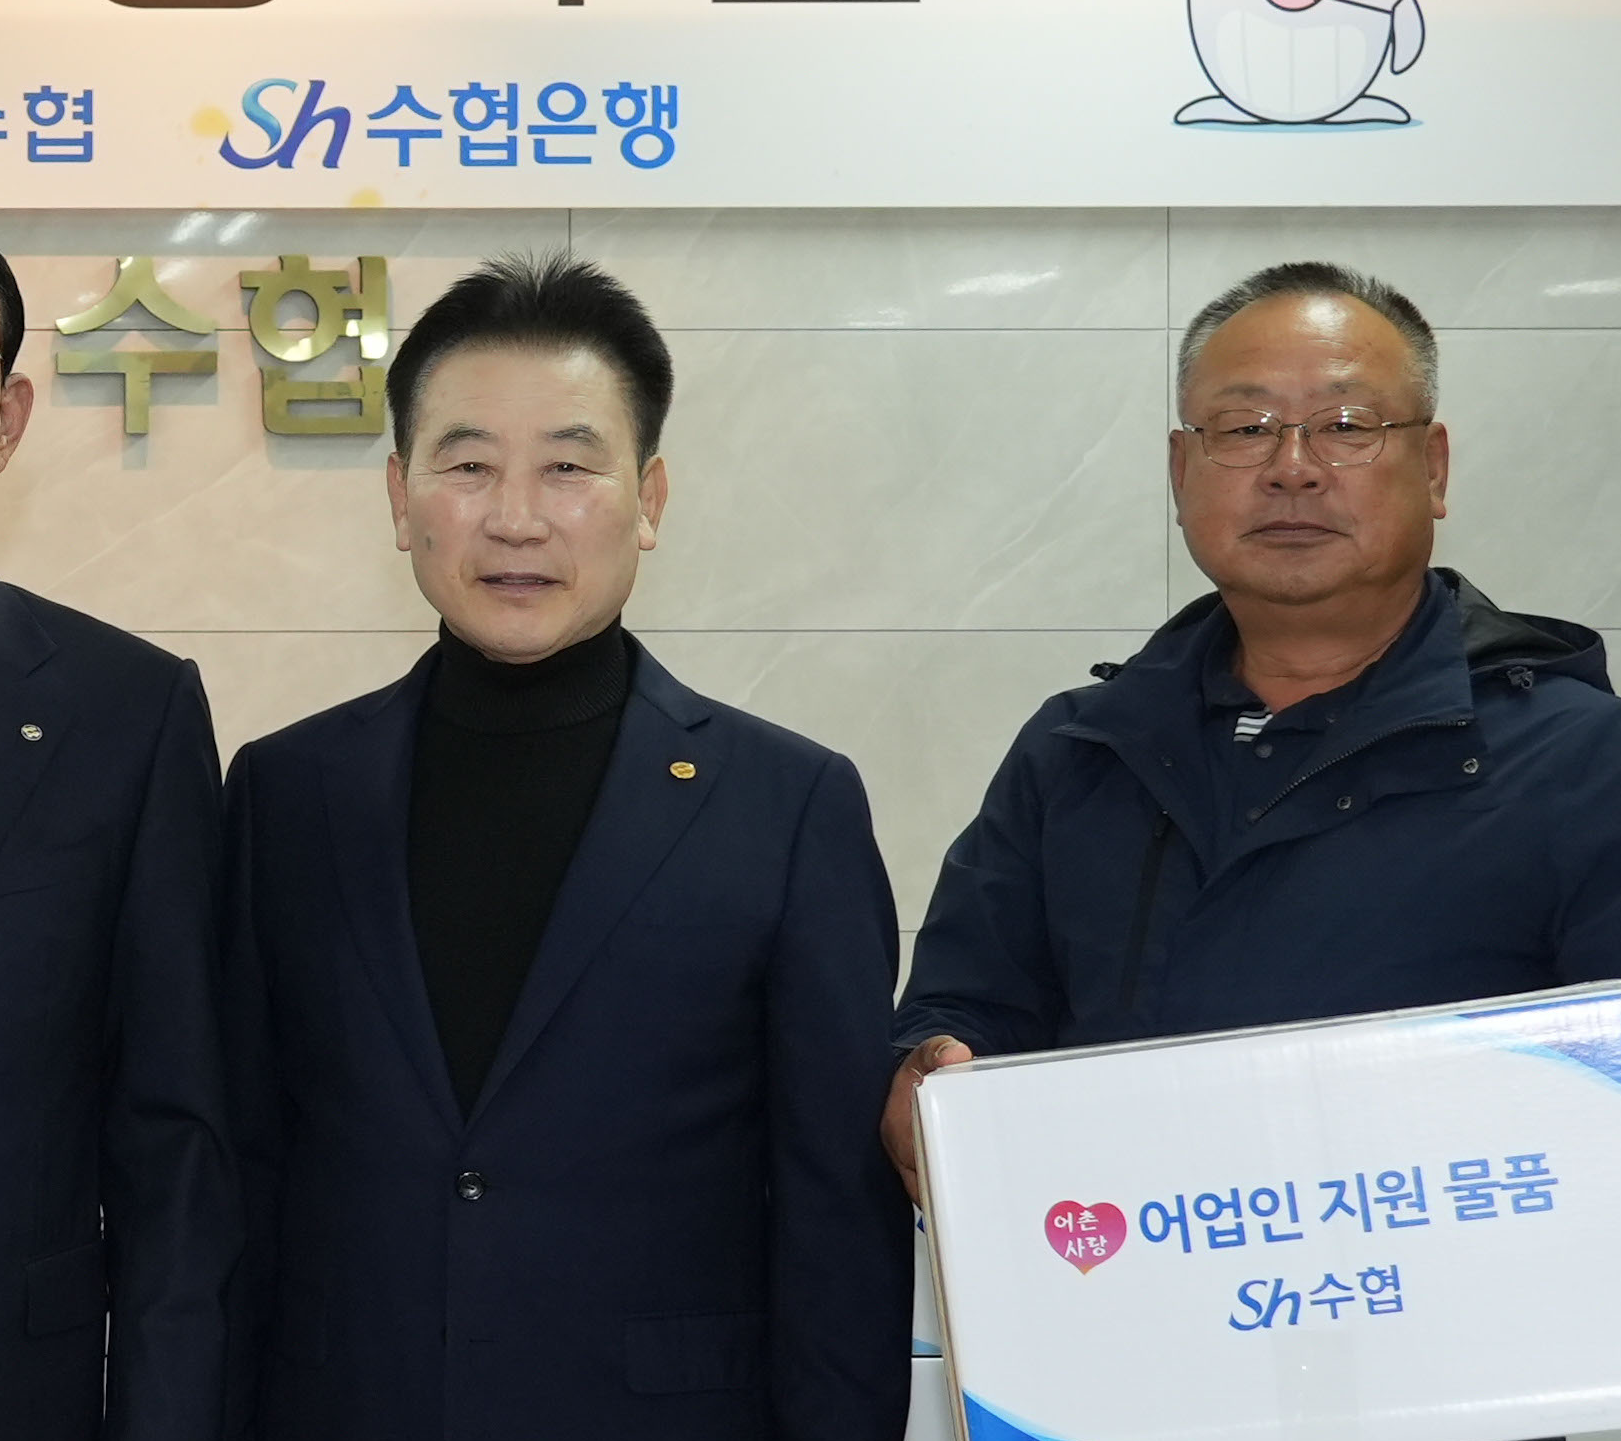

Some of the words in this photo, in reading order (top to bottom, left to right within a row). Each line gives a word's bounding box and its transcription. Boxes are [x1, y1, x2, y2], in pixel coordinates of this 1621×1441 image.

[220, 78, 682, 171] Sh수협은행
[54, 254, 389, 436] 수협
[1053, 1209, 1099, 1233] 어촌
[1140, 1182, 1305, 1254] 어업인
[1319, 1166, 1431, 1233] 지원
[1444, 1153, 1559, 1222] 물품
[1064, 1234, 1108, 1259] 사랑
[1228, 1264, 1404, 1332] Sh수협
